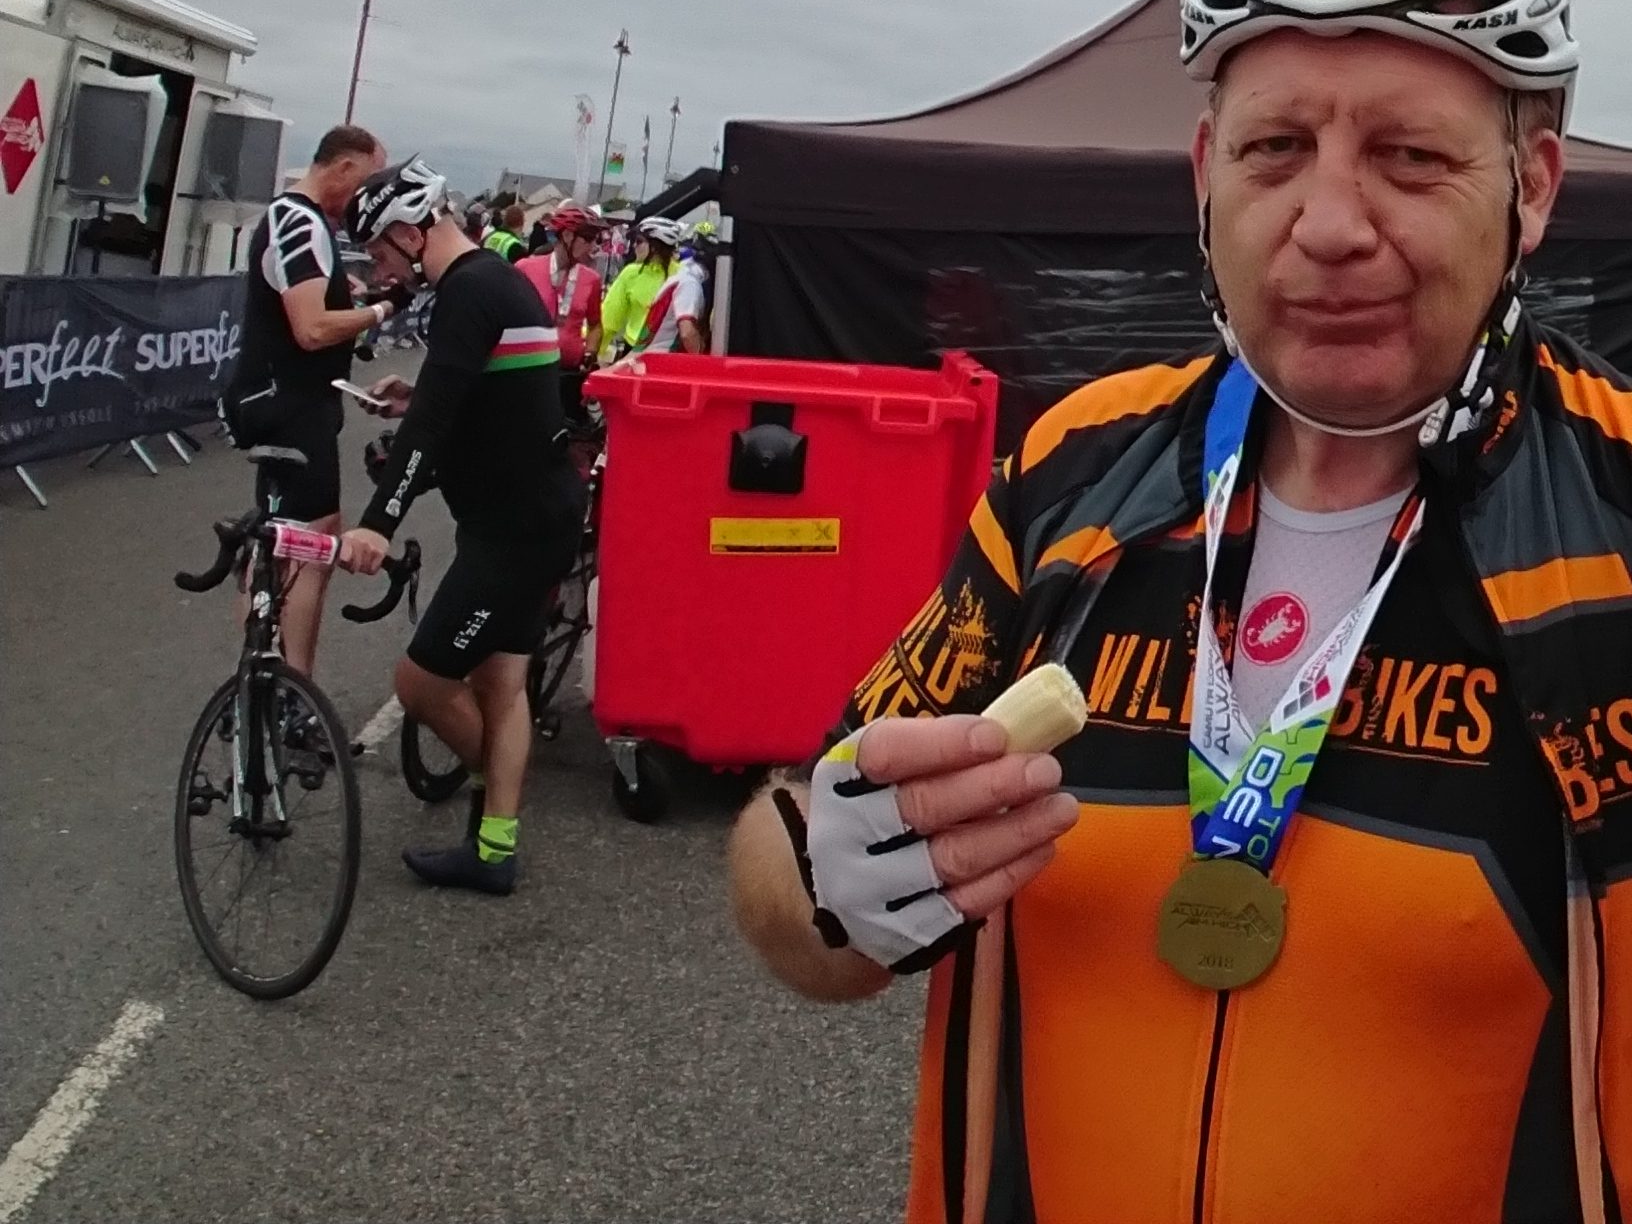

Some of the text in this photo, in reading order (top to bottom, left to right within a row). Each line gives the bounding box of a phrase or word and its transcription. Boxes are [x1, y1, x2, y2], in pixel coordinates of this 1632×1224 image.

[0, 320, 124, 407] ERfeet
[394, 449, 422, 499] POLARIS
[1210, 634, 1231, 755] ALWAY
[1246, 815, 1281, 864] TO
[1198, 954, 1234, 970] 2018
